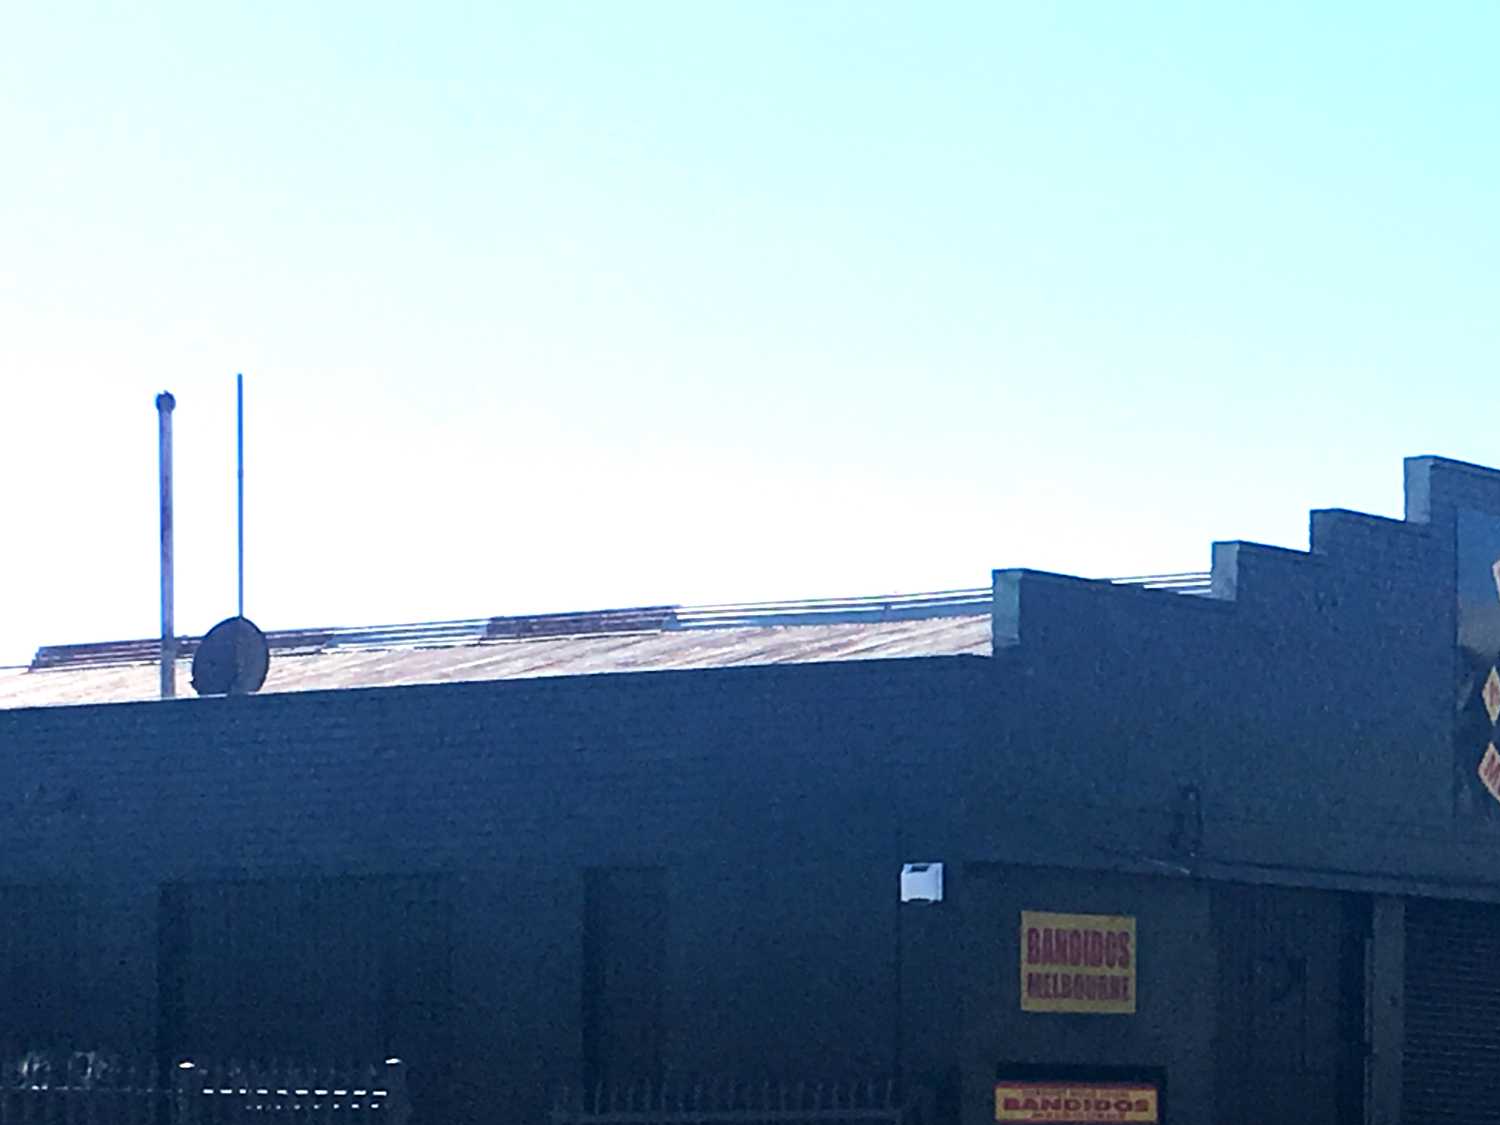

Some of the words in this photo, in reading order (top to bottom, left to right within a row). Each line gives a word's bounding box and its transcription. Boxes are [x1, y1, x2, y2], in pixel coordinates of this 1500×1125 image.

[1026, 926, 1131, 970] BANDIDOS
[1026, 971, 1131, 1002] MELBOURNE
[1003, 1097, 1150, 1113] BANDIDOS
